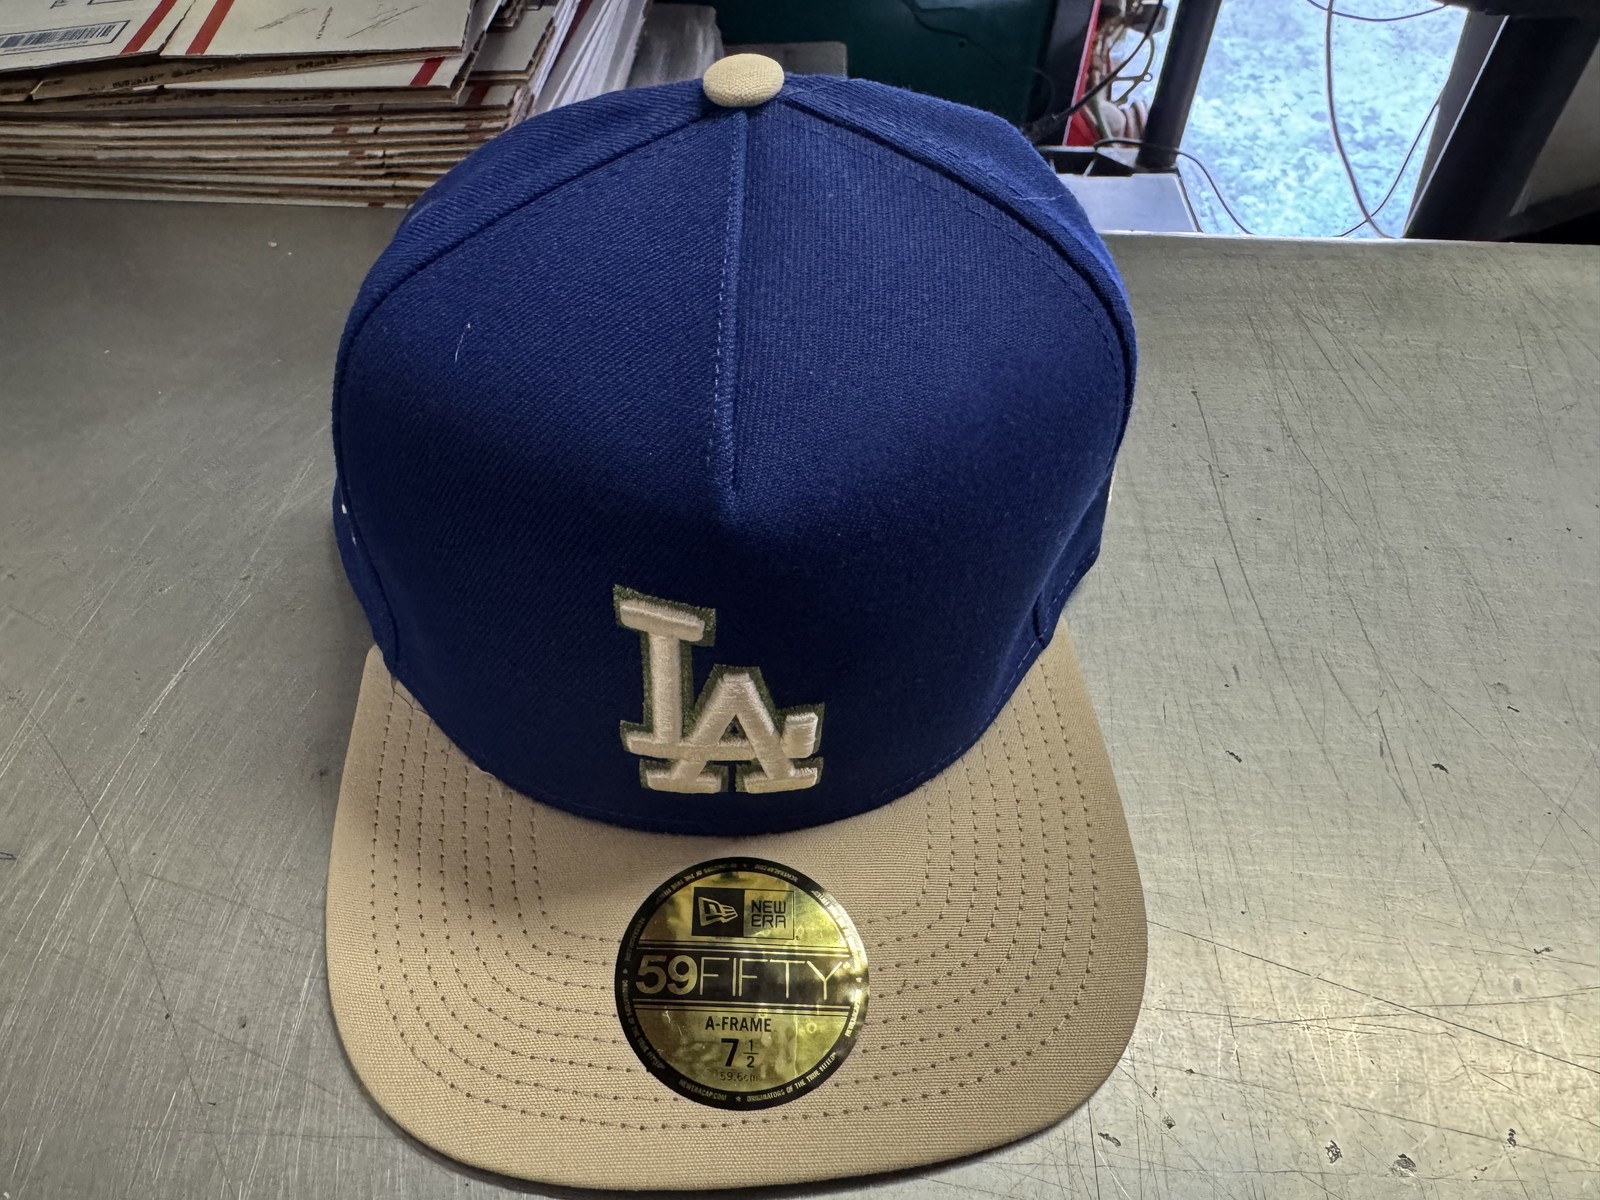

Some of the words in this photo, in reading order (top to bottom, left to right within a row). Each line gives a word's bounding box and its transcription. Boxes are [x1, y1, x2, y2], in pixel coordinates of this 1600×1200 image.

[612, 583, 826, 794] LA
[751, 899, 787, 914] NEW
[751, 913, 787, 929] ERA
[635, 954, 843, 1001] 59FIFTY
[704, 1015, 772, 1033] A-FRAME
[720, 1037, 739, 1068] 7
